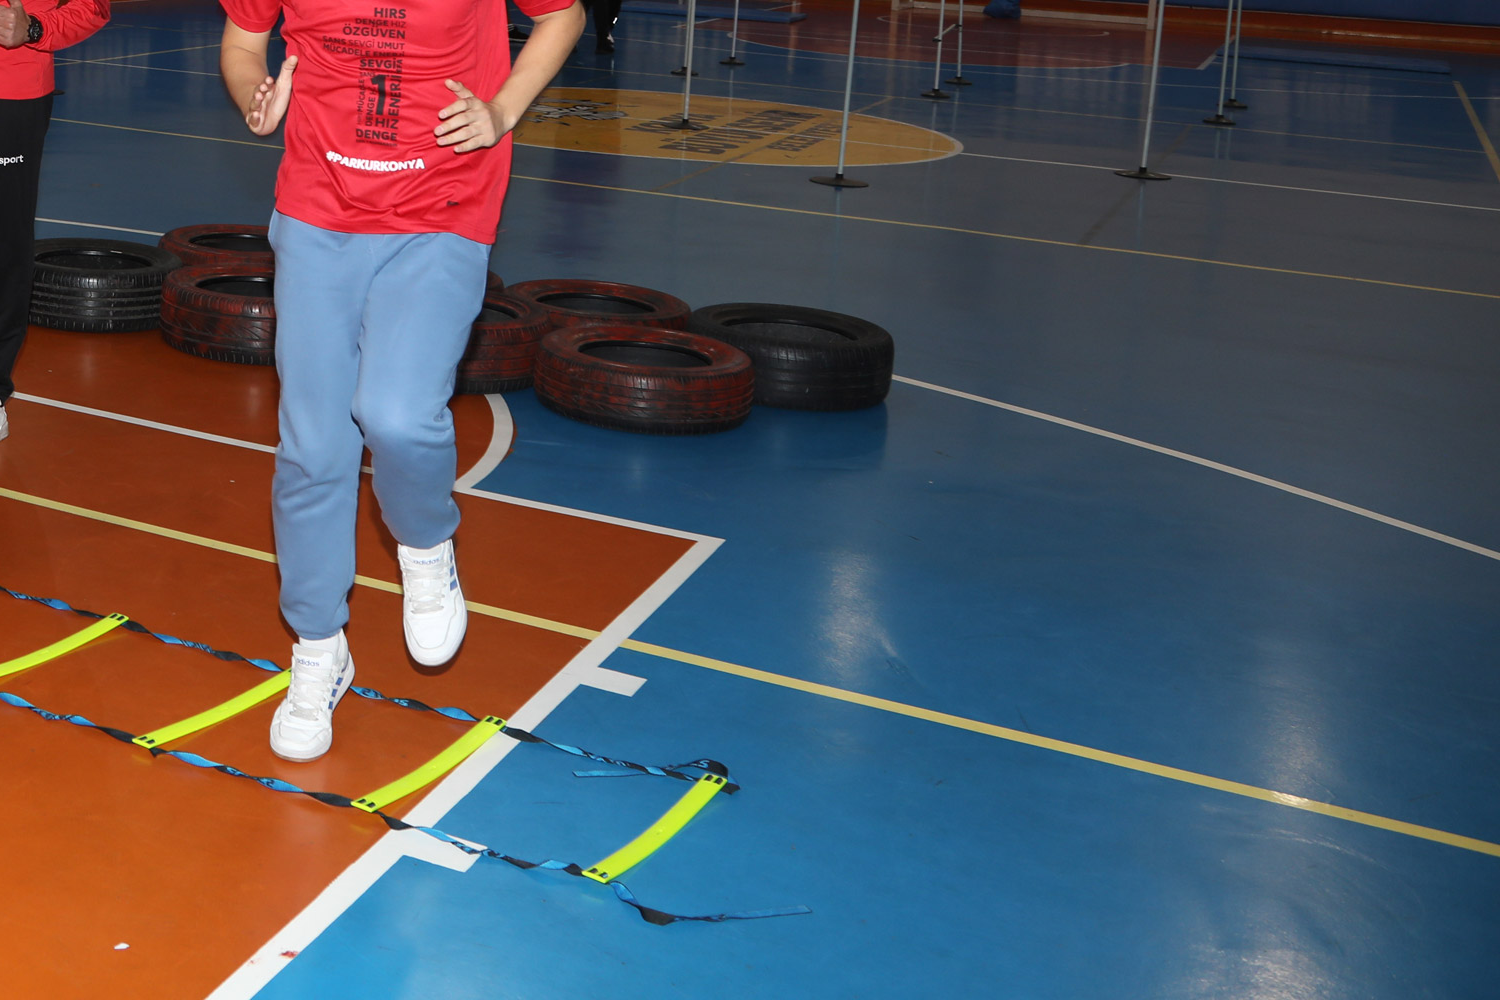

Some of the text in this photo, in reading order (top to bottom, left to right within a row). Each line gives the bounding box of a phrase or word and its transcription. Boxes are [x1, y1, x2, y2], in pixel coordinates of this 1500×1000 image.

[374, 7, 406, 19] HIRS
[355, 18, 406, 28] DENGE HIZ
[377, 41, 405, 50] UMUT
[375, 117, 399, 129] HIZ
[356, 128, 398, 141] DENGE
[326, 150, 426, 171] #PARKURKONYA
